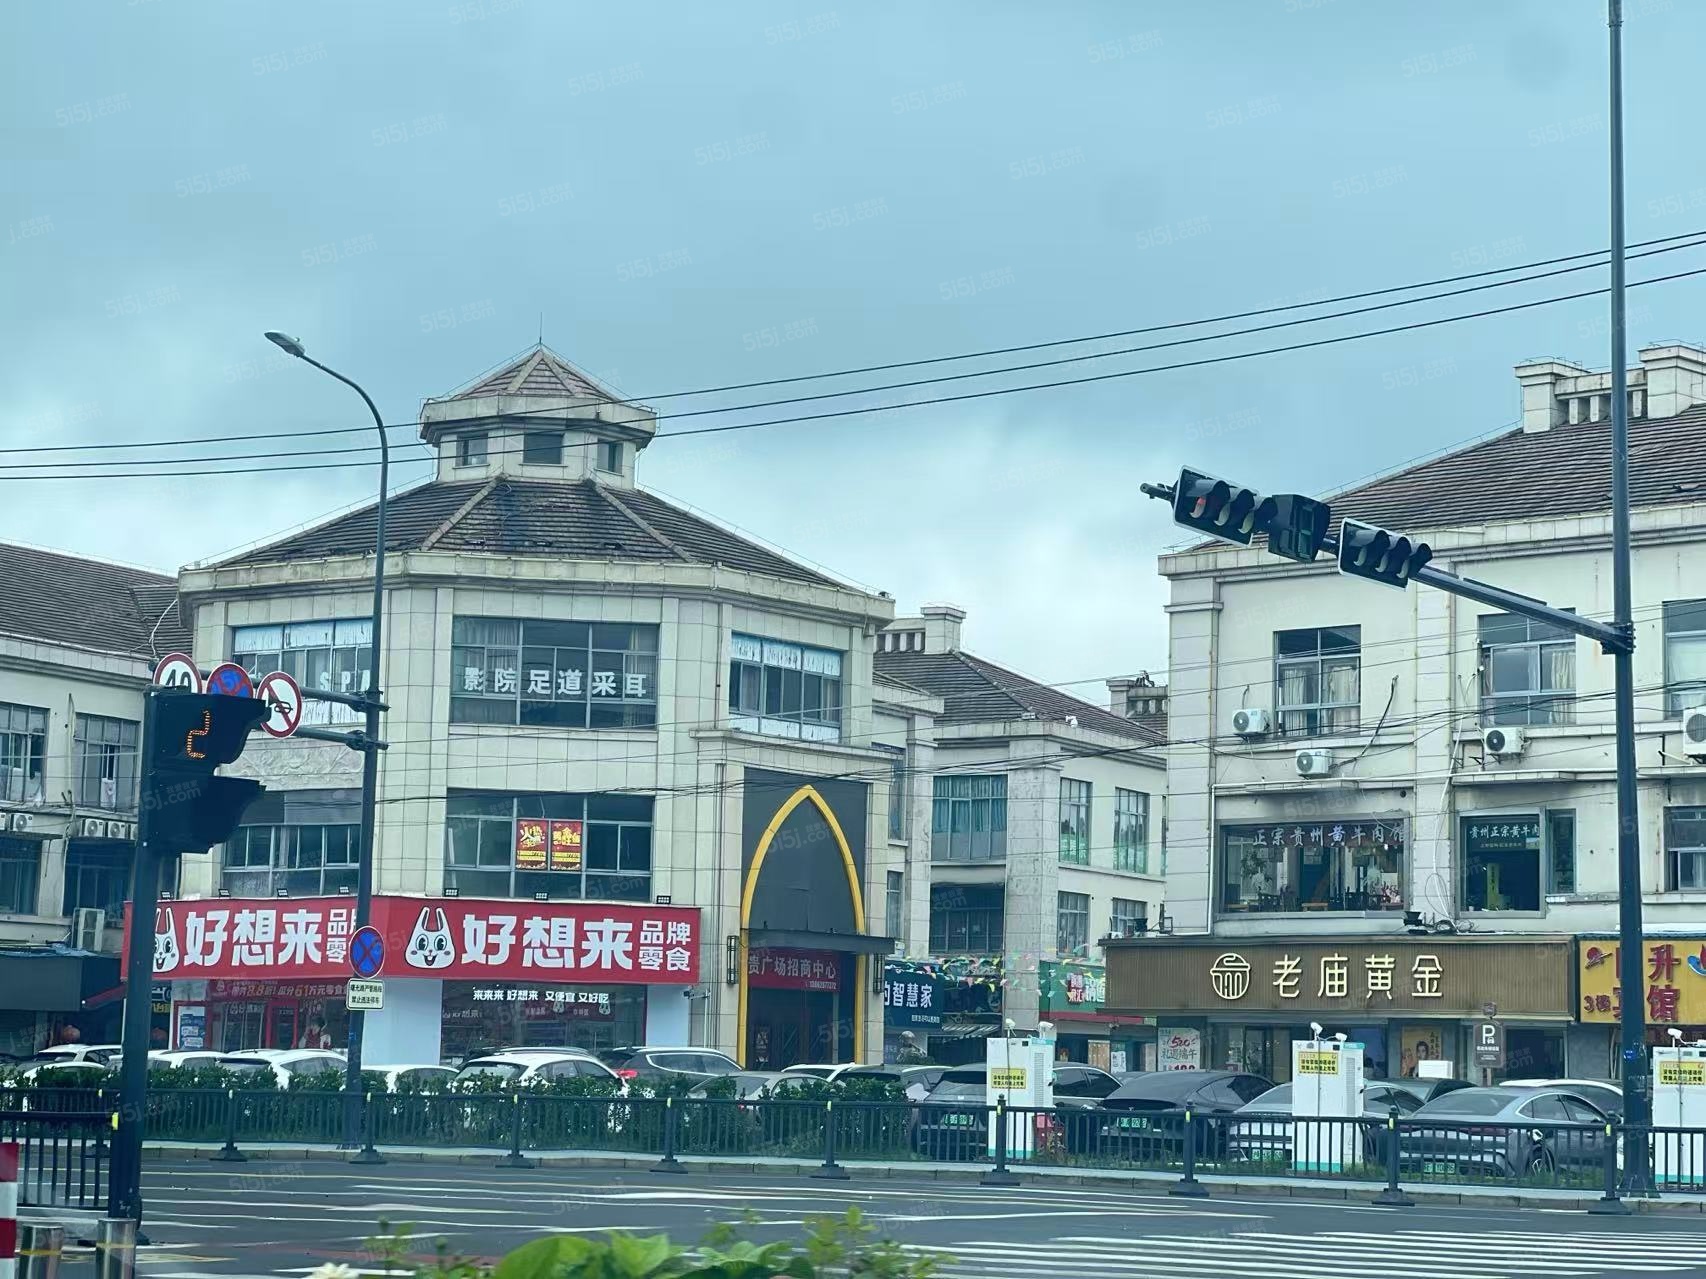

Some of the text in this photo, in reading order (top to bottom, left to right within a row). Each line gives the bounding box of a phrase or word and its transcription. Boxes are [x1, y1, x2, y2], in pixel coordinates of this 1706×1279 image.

[463, 667, 647, 698] 影院足道采耳
[186, 709, 212, 759] 2
[183, 908, 324, 967] 好想来
[461, 915, 634, 970] 好想来
[639, 920, 691, 945] 品牌
[638, 946, 691, 972] 零食
[1272, 952, 1443, 1000] 老庙黄金
[472, 989, 505, 1001] 来来来
[506, 989, 539, 1002] 好想来
[544, 990, 576, 1003] 又便宜
